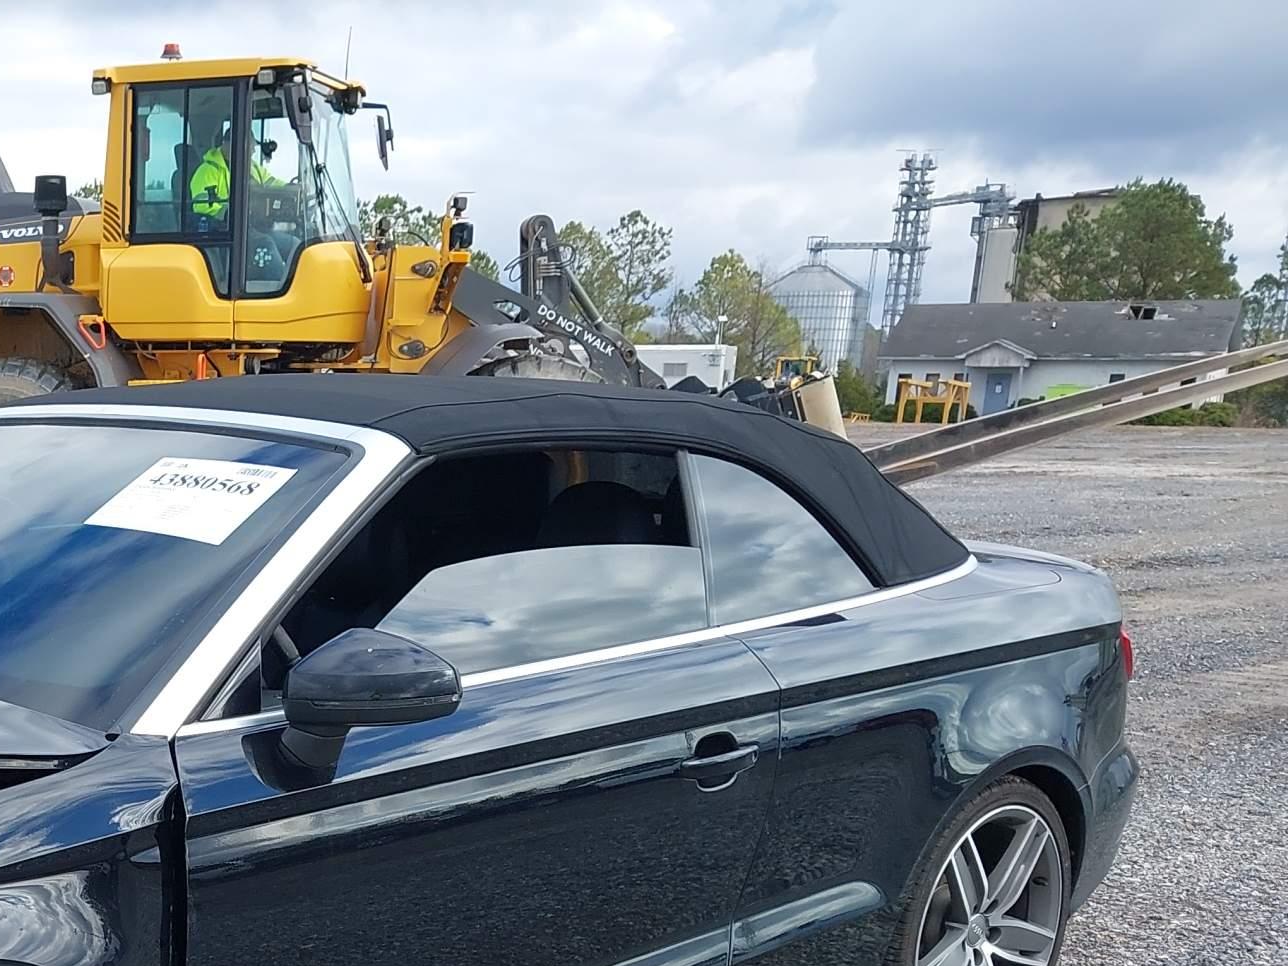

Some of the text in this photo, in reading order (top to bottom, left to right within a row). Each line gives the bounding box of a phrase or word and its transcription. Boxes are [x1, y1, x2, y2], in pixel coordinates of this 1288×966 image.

[537, 304, 615, 357] DO NOT WALK
[149, 472, 261, 496] 43880568
